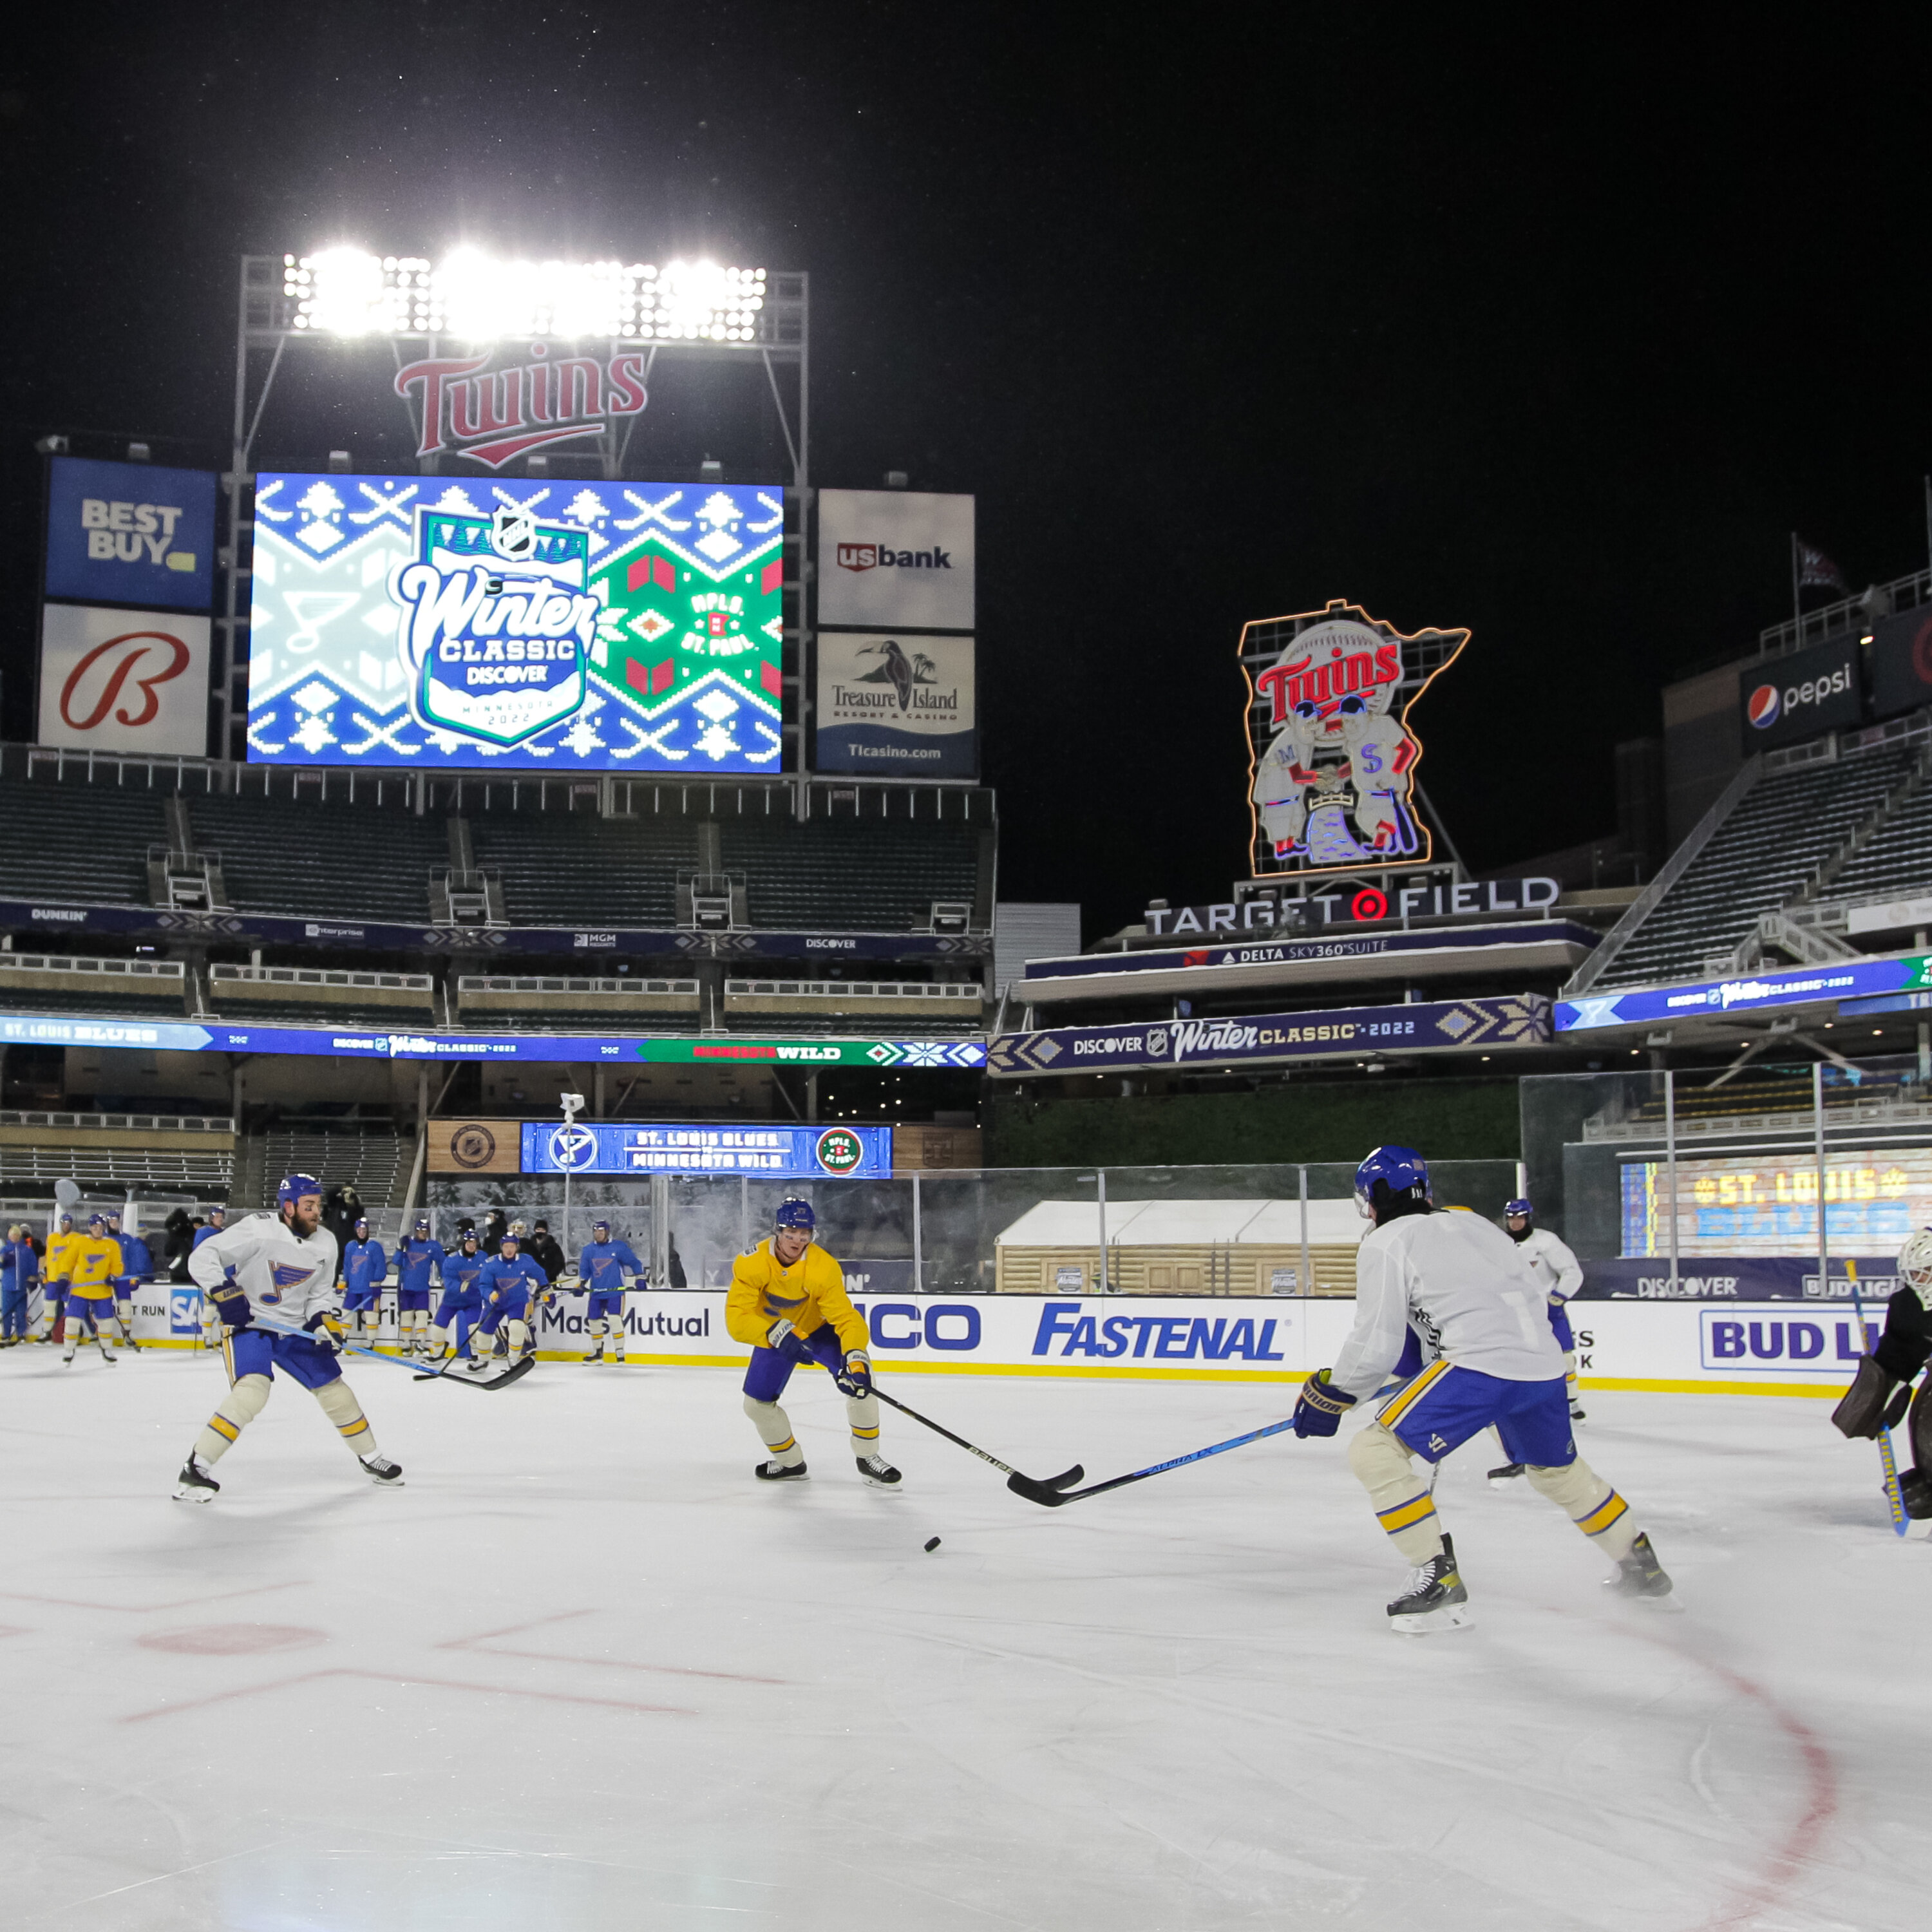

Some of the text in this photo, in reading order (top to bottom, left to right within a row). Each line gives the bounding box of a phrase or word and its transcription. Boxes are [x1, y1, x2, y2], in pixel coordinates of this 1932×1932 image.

[394, 342, 648, 457] Twins
[82, 498, 182, 535] BEST
[88, 530, 173, 565] BUY
[400, 564, 600, 668] Winter
[439, 639, 576, 662] CLASSIC
[467, 665, 549, 686] DISCOVER
[1258, 644, 1400, 723] Twins
[831, 685, 958, 710] Treasure Island
[1783, 663, 1852, 716] pepsi
[462, 700, 553, 714] MINNESOTA
[488, 713, 530, 726] 2022
[1361, 743, 1383, 773] S
[31, 909, 88, 922] DUNKIN'
[1144, 876, 1560, 935] TARGET FIELD
[589, 934, 616, 942] MGM
[806, 938, 856, 949] DISCOVER
[1240, 947, 1284, 962] DELTA
[74, 1026, 158, 1043] BLUES
[1074, 1036, 1143, 1056] DISCOVER
[1170, 1020, 1258, 1063] Winter
[1258, 1023, 1356, 1045] CLASSIC
[1369, 1021, 1415, 1036] 2022
[437, 1043, 488, 1053] CLASSIC
[776, 1046, 842, 1060] WILD
[636, 1131, 779, 1147] ST. LOUIS BLUES
[632, 1153, 782, 1168] MINNESOTA WILD
[1718, 1169, 1877, 1205] ST. LOUIS
[1696, 1202, 1910, 1238] BLUES
[1637, 1276, 1737, 1298] DISCOVER
[142, 1305, 166, 1316] RUN
[1032, 1302, 1284, 1361] FASTENAL
[1712, 1321, 1824, 1359] BUD
[1151, 1454, 1193, 1473] ALPHA
